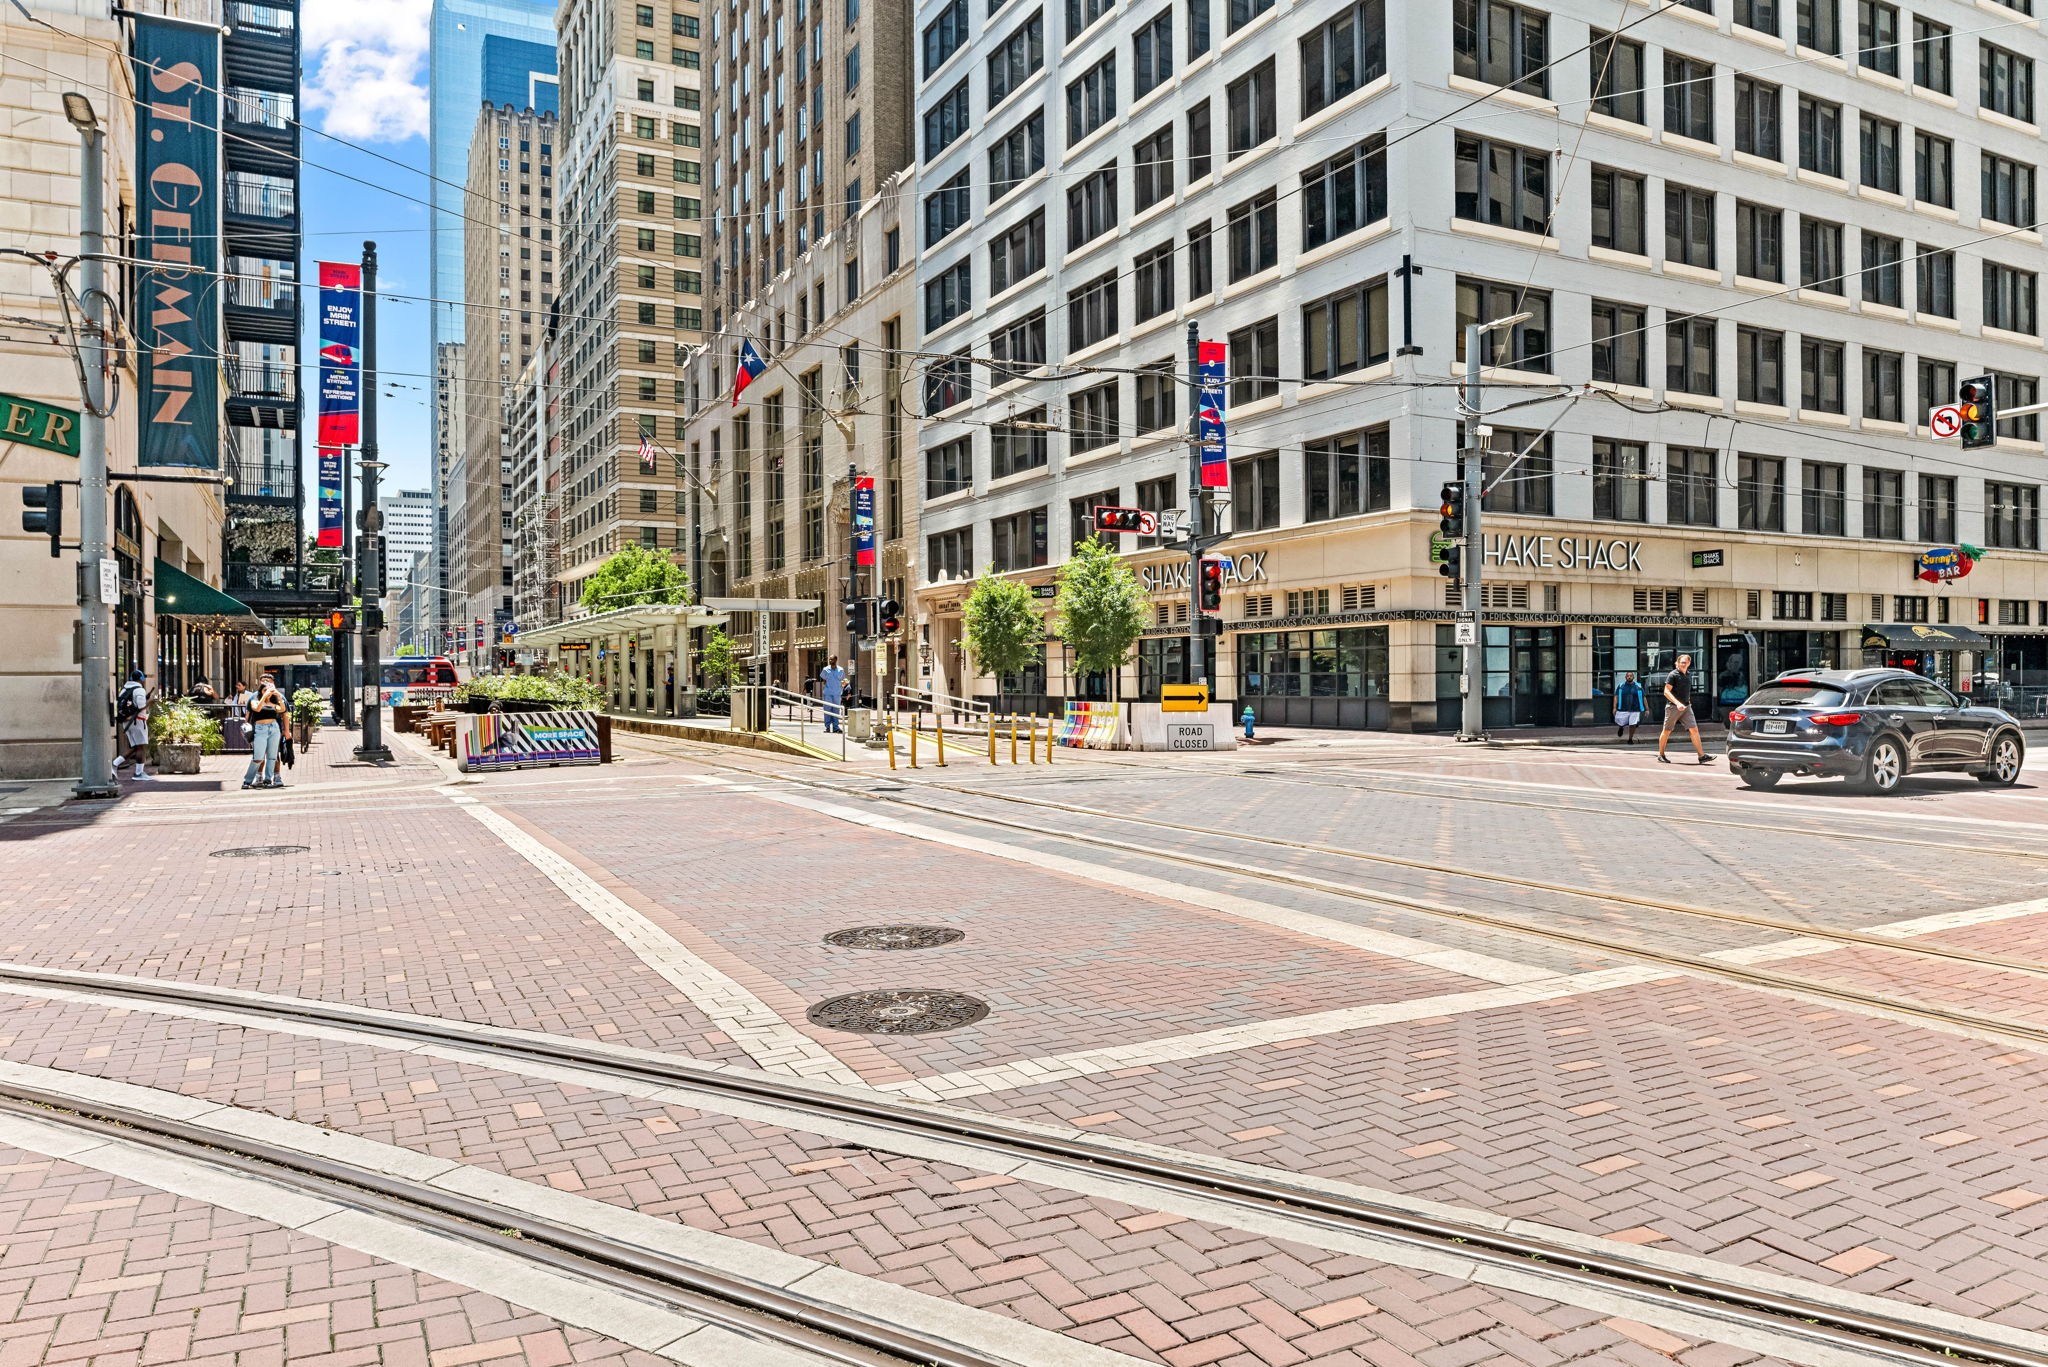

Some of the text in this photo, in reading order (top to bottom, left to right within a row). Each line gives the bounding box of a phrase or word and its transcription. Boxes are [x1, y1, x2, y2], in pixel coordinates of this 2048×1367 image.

[150, 57, 204, 425] ST. GERMAIN
[327, 305, 353, 314] ENJOY
[329, 312, 351, 320] MAIN
[323, 318, 357, 328] STREET!
[1483, 533, 1643, 571] HAKE SHACK
[1702, 557, 1720, 565] SHACK
[1922, 552, 1958, 565] Sunny's
[1938, 565, 1961, 578] BAR
[1237, 621, 1261, 629] SHAKES
[1263, 620, 1277, 629] HOT
[1277, 618, 1297, 628] DOGS
[1300, 615, 1343, 627] CONCRETES
[1345, 613, 1373, 624] FLOATS
[1377, 610, 1406, 621] CONES
[1414, 610, 1448, 620] FROZEN
[1489, 612, 1511, 621] FRIES
[1514, 613, 1544, 622] SHAKES
[1546, 613, 1562, 623] HOT
[1565, 614, 1586, 623] DOGS
[1588, 615, 1633, 624] CONCRETES
[1634, 616, 1661, 625] FLOATS
[1662, 616, 1687, 625] CONES
[1689, 617, 1720, 625] BURGERS
[534, 730, 584, 739] MORE SPACE
[1178, 727, 1203, 736] ROAD
[1173, 739, 1208, 749] CLOSED
